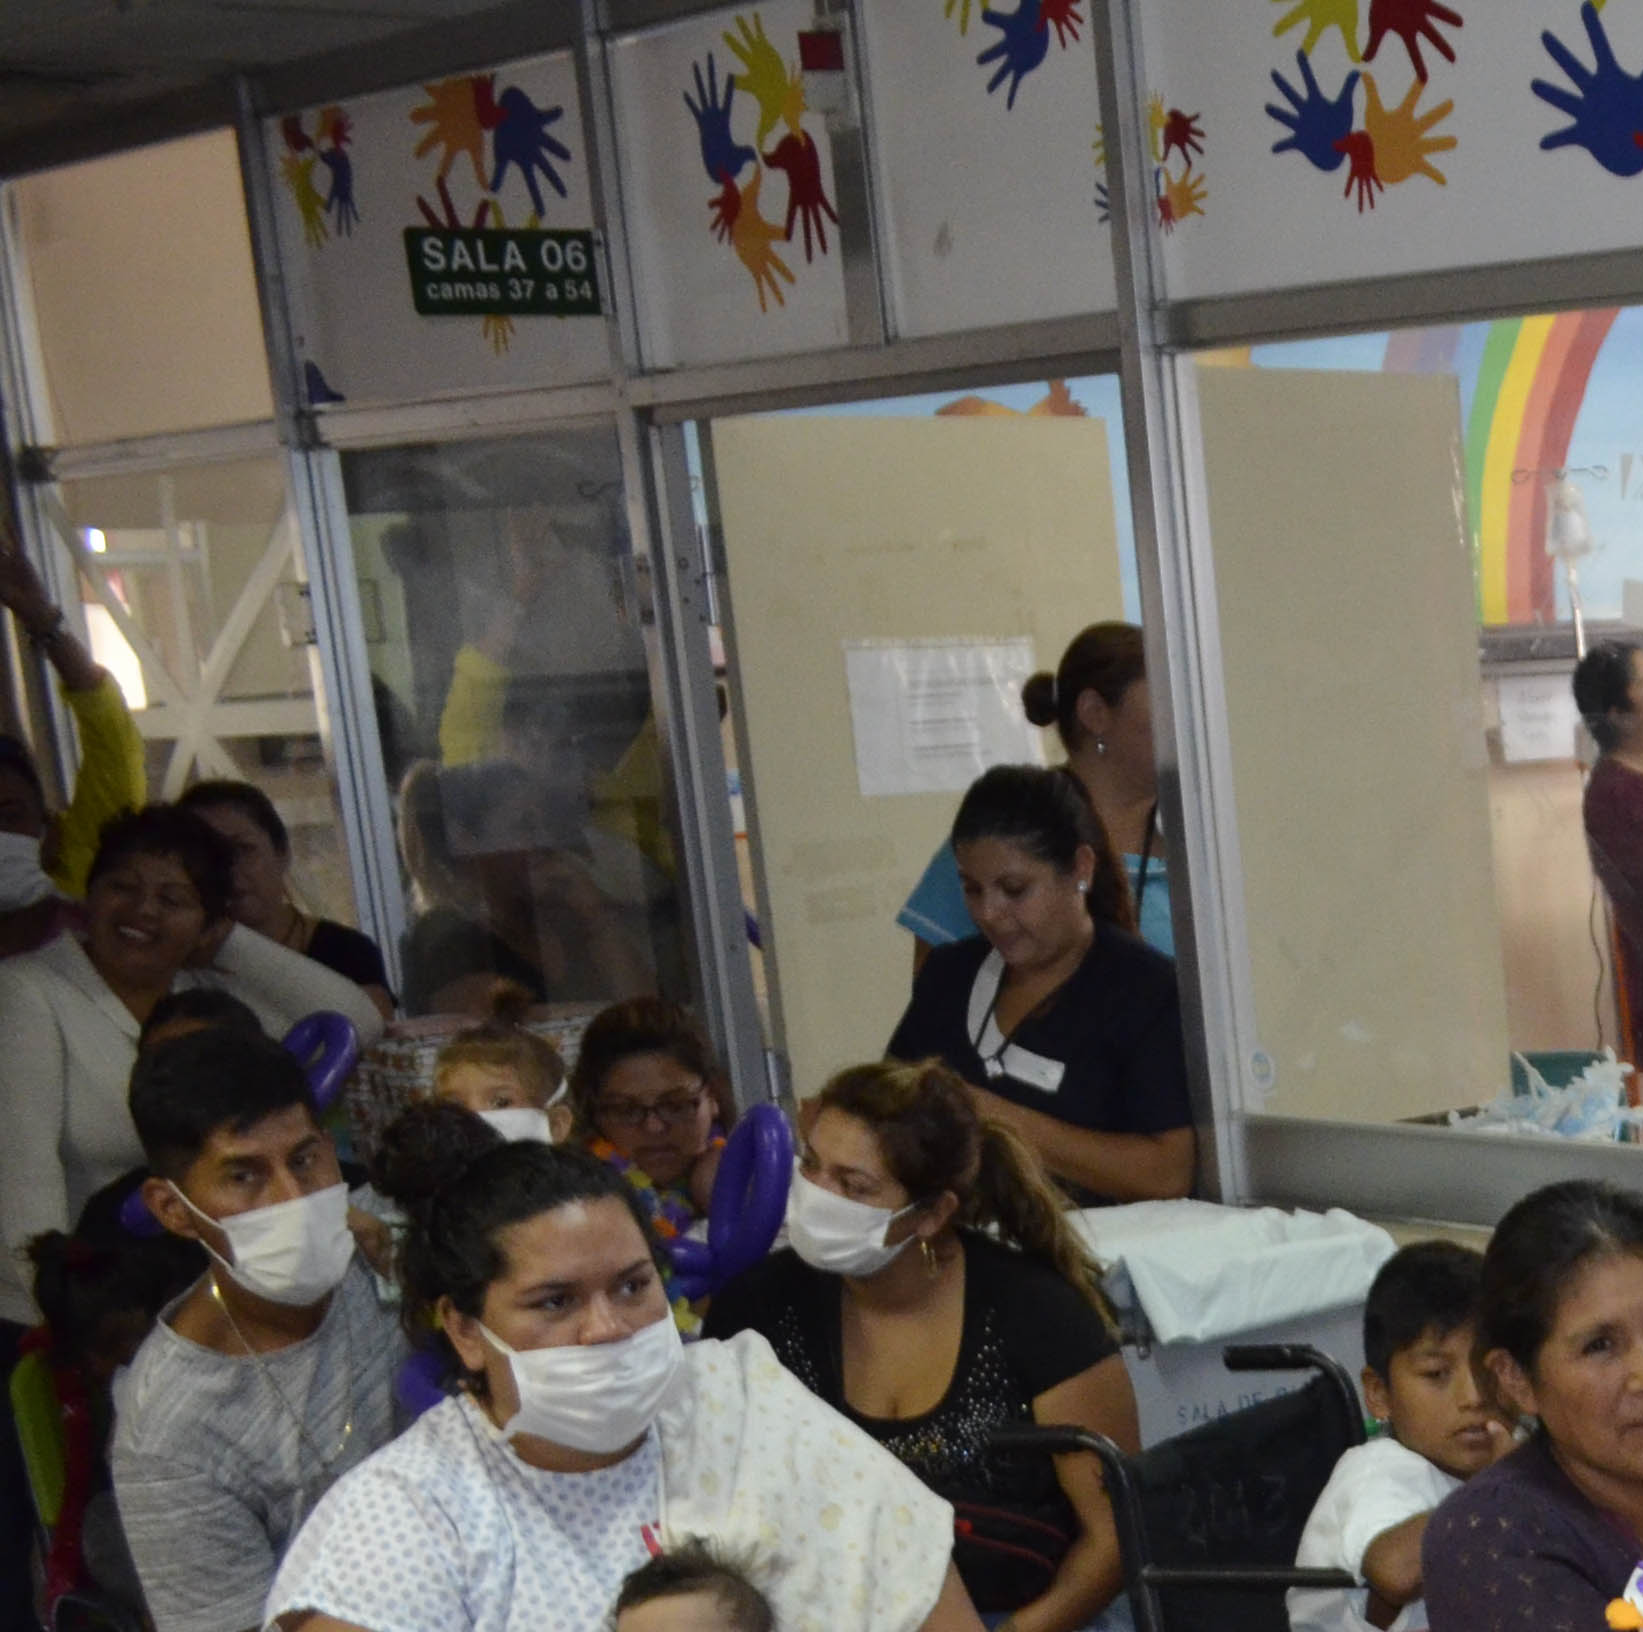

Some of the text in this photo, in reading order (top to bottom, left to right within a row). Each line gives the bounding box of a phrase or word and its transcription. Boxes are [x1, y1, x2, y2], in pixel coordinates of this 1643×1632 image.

[422, 238, 588, 273] SALA 06
[426, 278, 594, 300] camas 37 a 54
